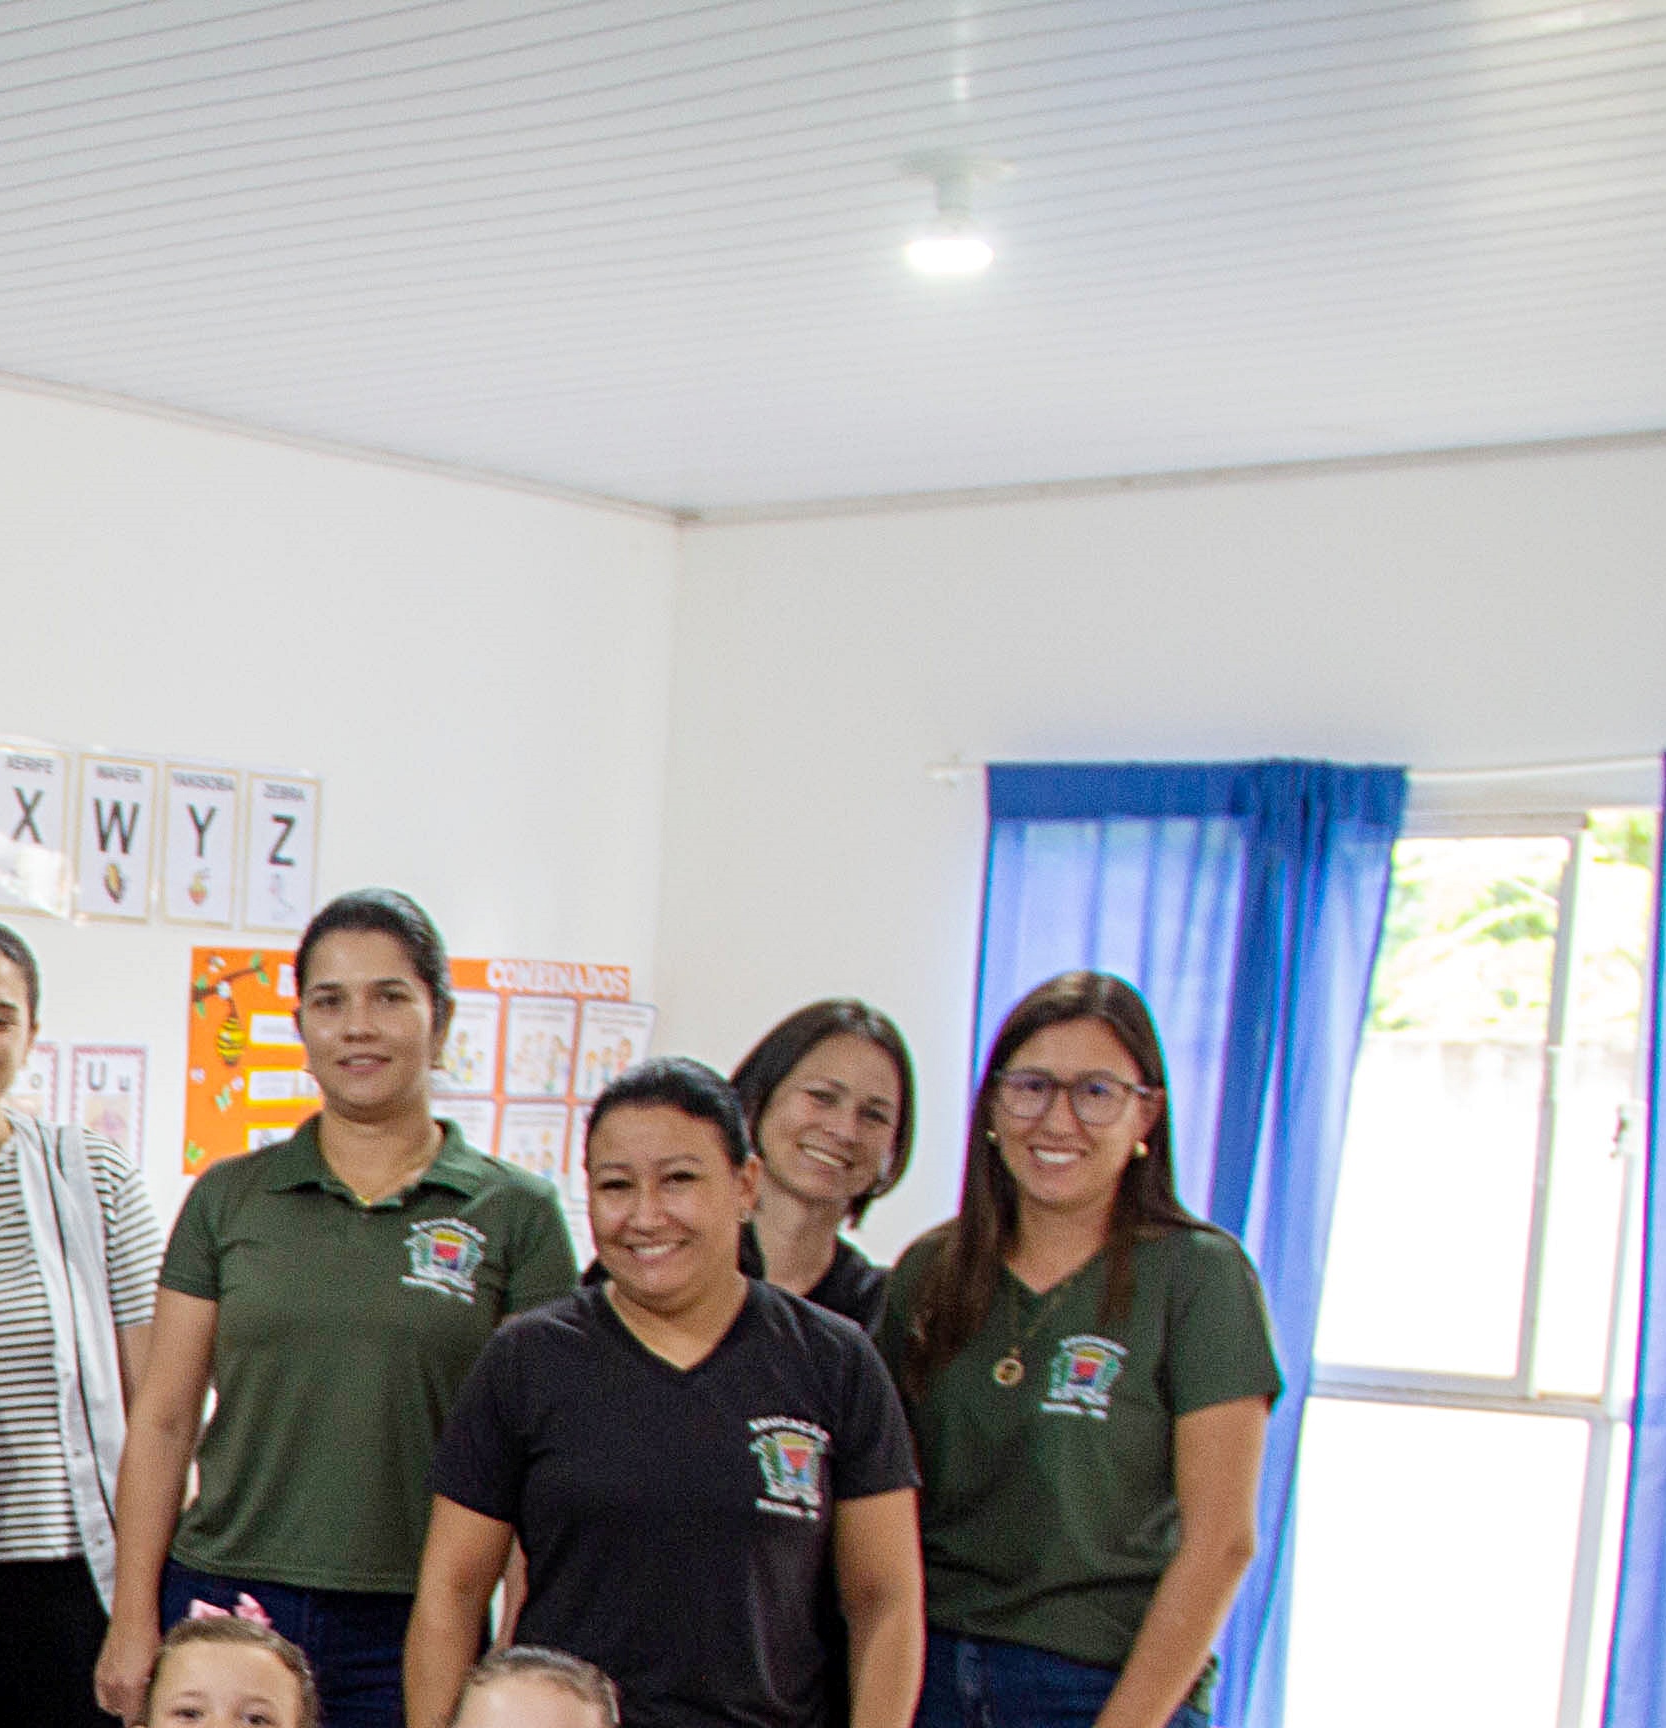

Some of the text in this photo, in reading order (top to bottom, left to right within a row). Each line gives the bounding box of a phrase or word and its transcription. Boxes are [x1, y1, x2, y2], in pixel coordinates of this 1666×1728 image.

[14, 788, 42, 843] X
[95, 800, 138, 854] W
[189, 806, 215, 856] Y
[269, 815, 295, 866] Z
